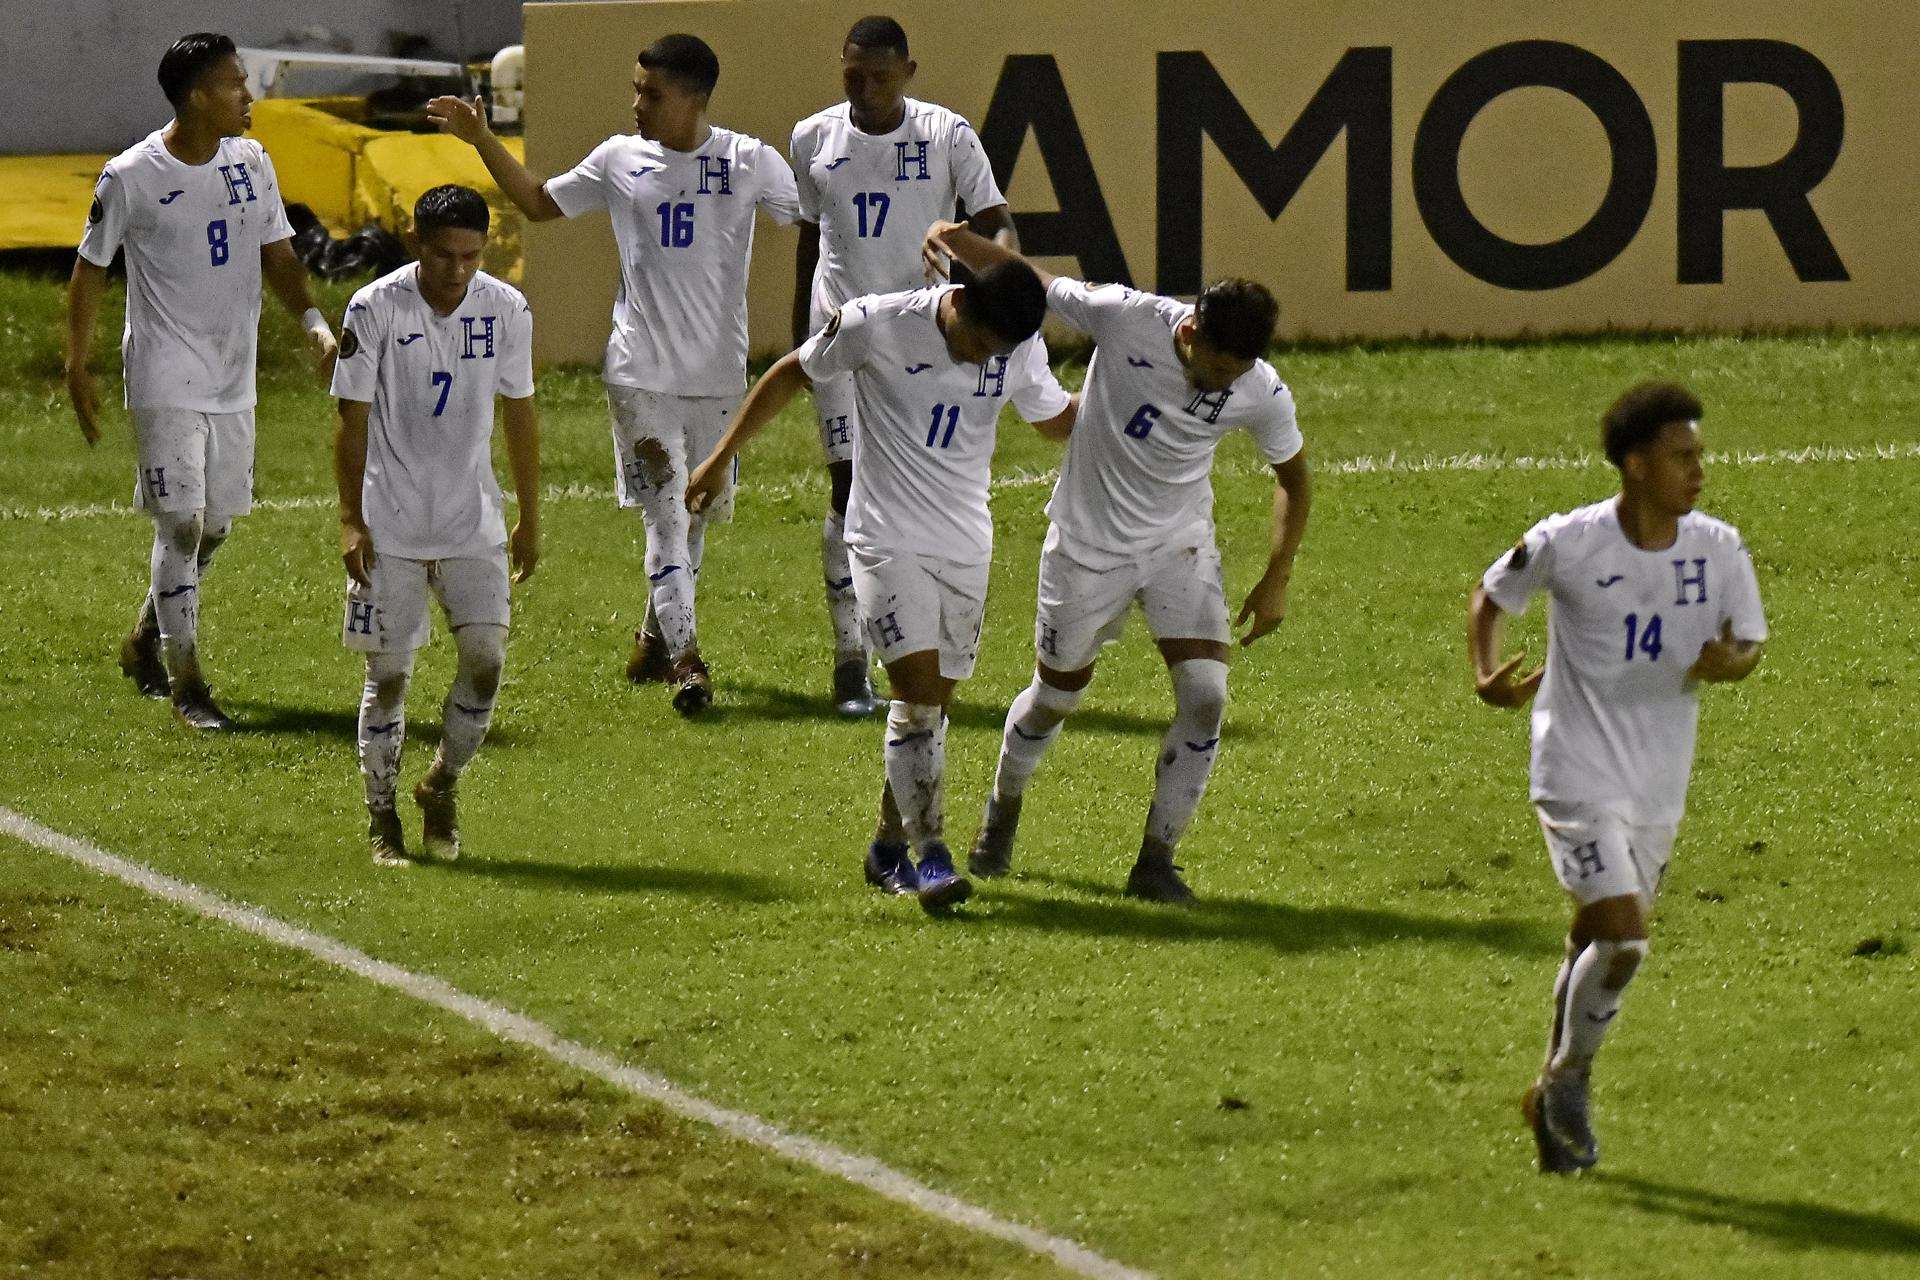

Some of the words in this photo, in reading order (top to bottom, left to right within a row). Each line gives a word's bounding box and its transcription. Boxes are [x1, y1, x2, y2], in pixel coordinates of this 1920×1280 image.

[697, 156, 733, 195] H
[895, 141, 931, 181] H
[951, 38, 1851, 293] AMOR
[218, 163, 257, 205] H
[656, 202, 695, 248] 16
[852, 192, 891, 238] 17
[207, 219, 230, 267] 8
[460, 316, 497, 359] H
[432, 371, 453, 417] 7
[973, 356, 1009, 397] H
[925, 403, 961, 448] 11
[1123, 403, 1162, 439] 6
[1182, 388, 1234, 424] H
[825, 415, 851, 448] H
[1672, 558, 1708, 605] H
[348, 601, 374, 634] H
[1624, 613, 1663, 662] 14
